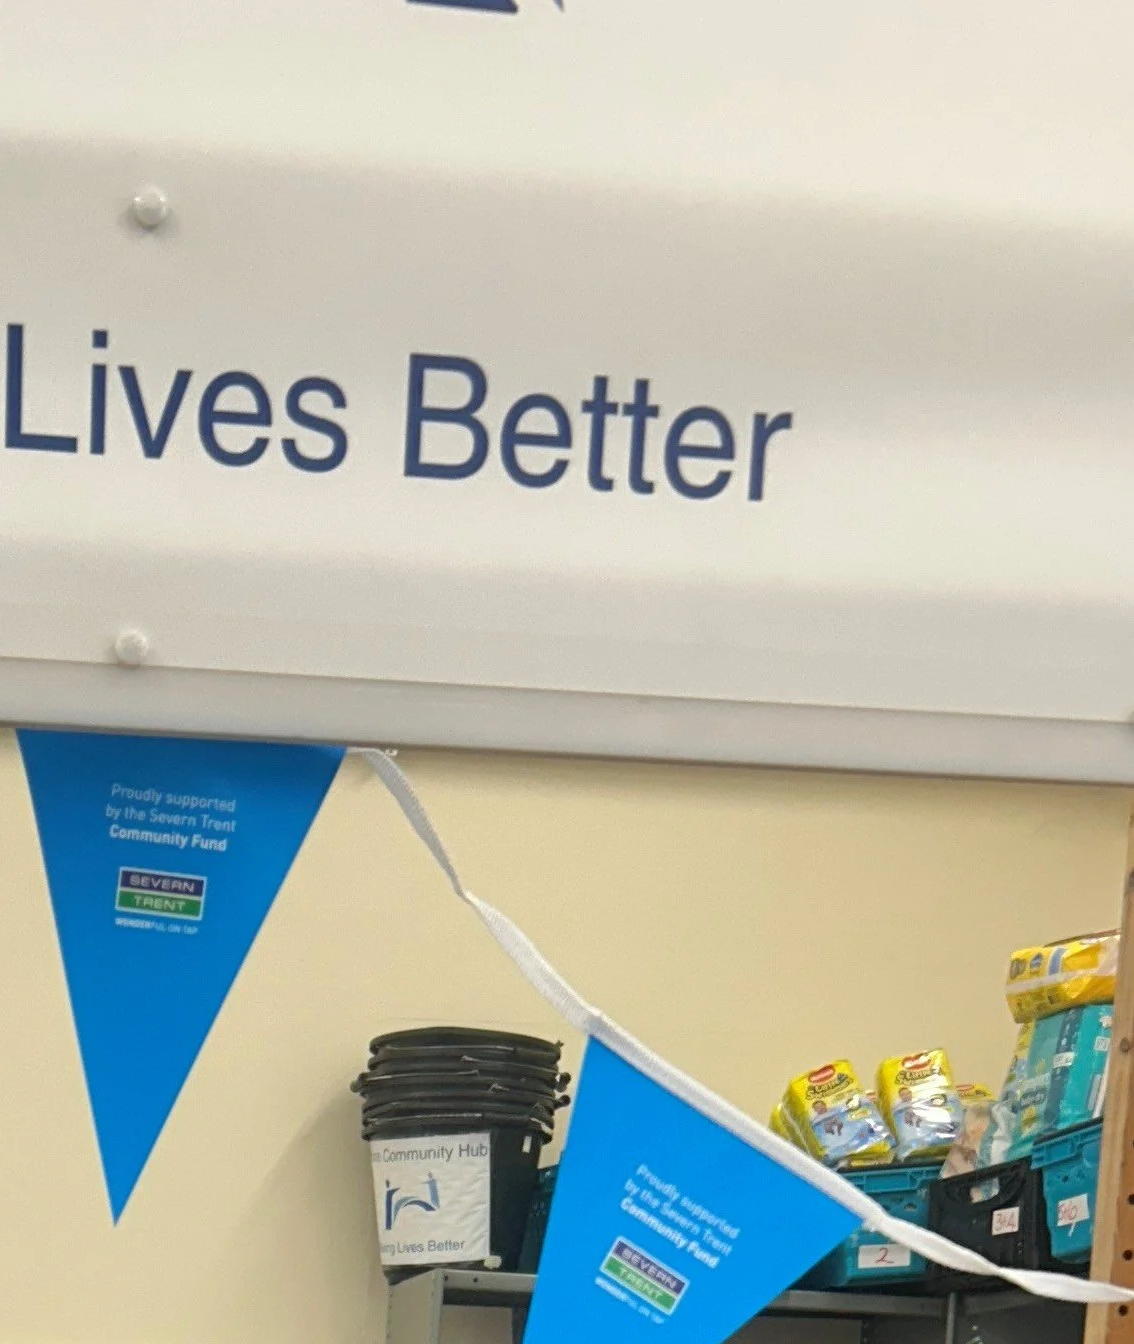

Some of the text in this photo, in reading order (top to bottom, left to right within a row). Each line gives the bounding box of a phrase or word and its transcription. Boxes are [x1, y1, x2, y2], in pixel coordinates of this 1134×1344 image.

[4, 323, 348, 472] Lives
[403, 352, 792, 501] Better
[111, 783, 236, 812] Proudly supported
[105, 803, 236, 832] by the Severn Trent
[109, 824, 228, 851] Community Fund
[129, 874, 195, 893] SEVERN
[133, 895, 186, 912] TRENT
[383, 1145, 453, 1163] Community
[458, 1143, 488, 1158] Hub
[636, 1164, 741, 1239] Proudly supported
[620, 1196, 720, 1269] Community Fund
[660, 1202, 701, 1235] Severn
[702, 1228, 732, 1256] Trent
[428, 1240, 465, 1252] Better
[876, 1248, 894, 1263] 2
[621, 1246, 677, 1290] SEVERN
[619, 1267, 663, 1301] TRENT
